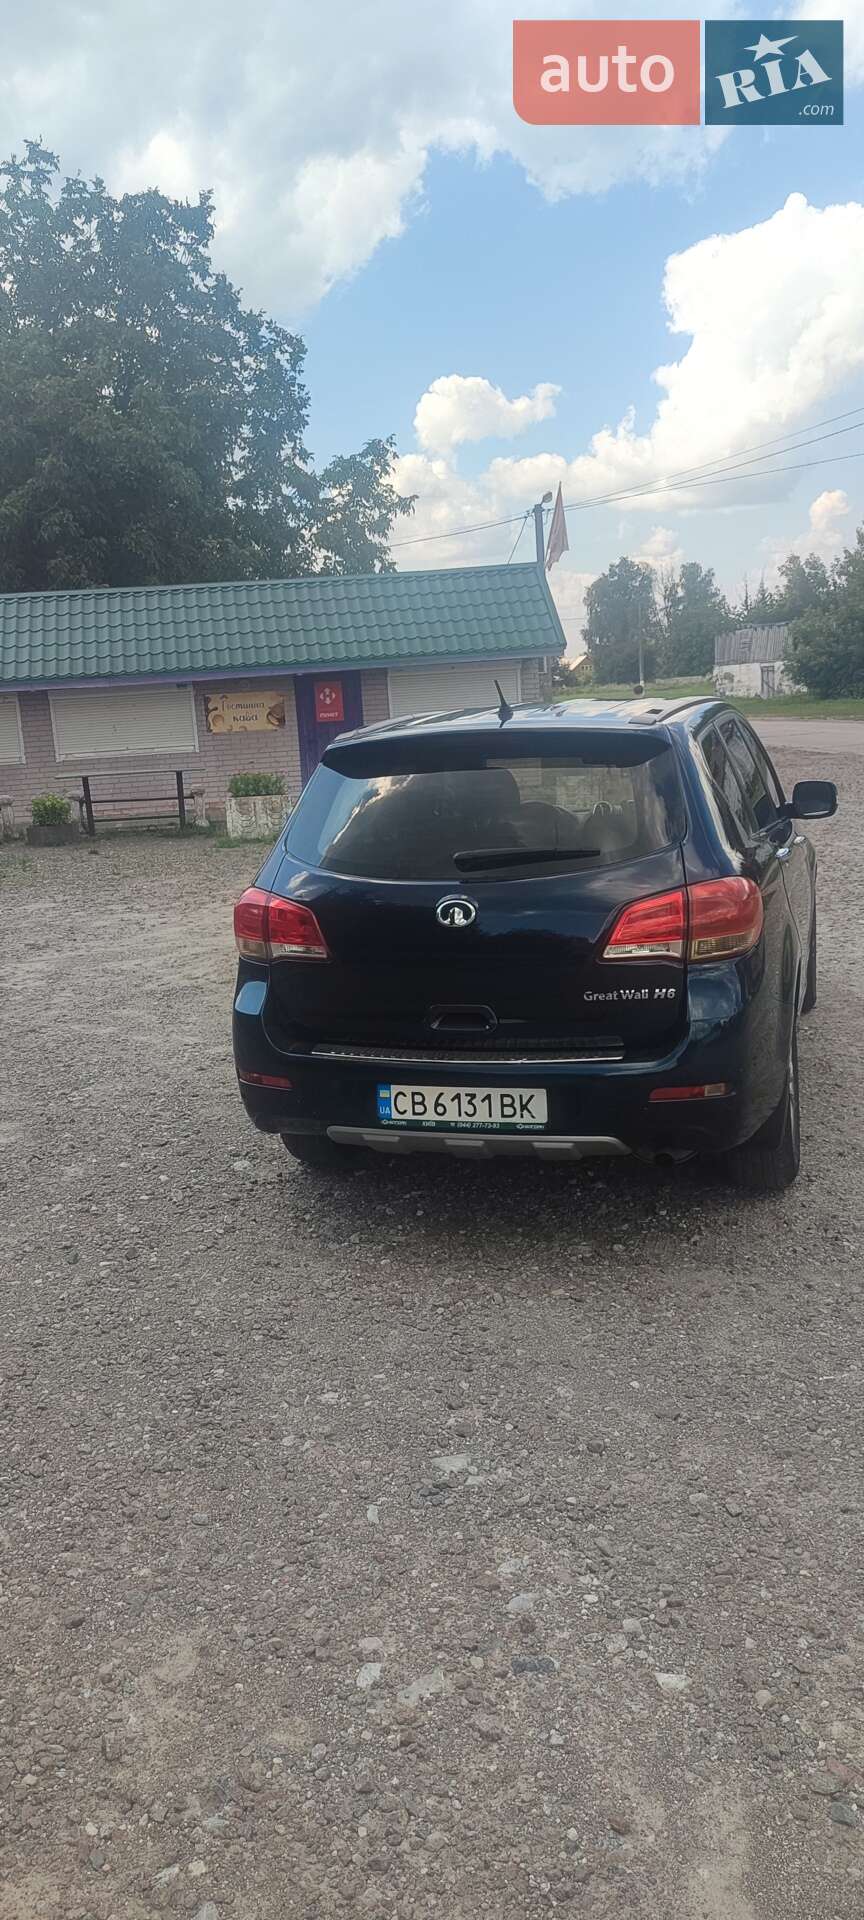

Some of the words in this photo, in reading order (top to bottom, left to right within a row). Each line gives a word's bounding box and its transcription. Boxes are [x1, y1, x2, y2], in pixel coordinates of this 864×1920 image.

[583, 990, 618, 1001] Great
[620, 989, 649, 1000] Wall
[653, 988, 676, 999] H6
[379, 1106, 391, 1115] UA
